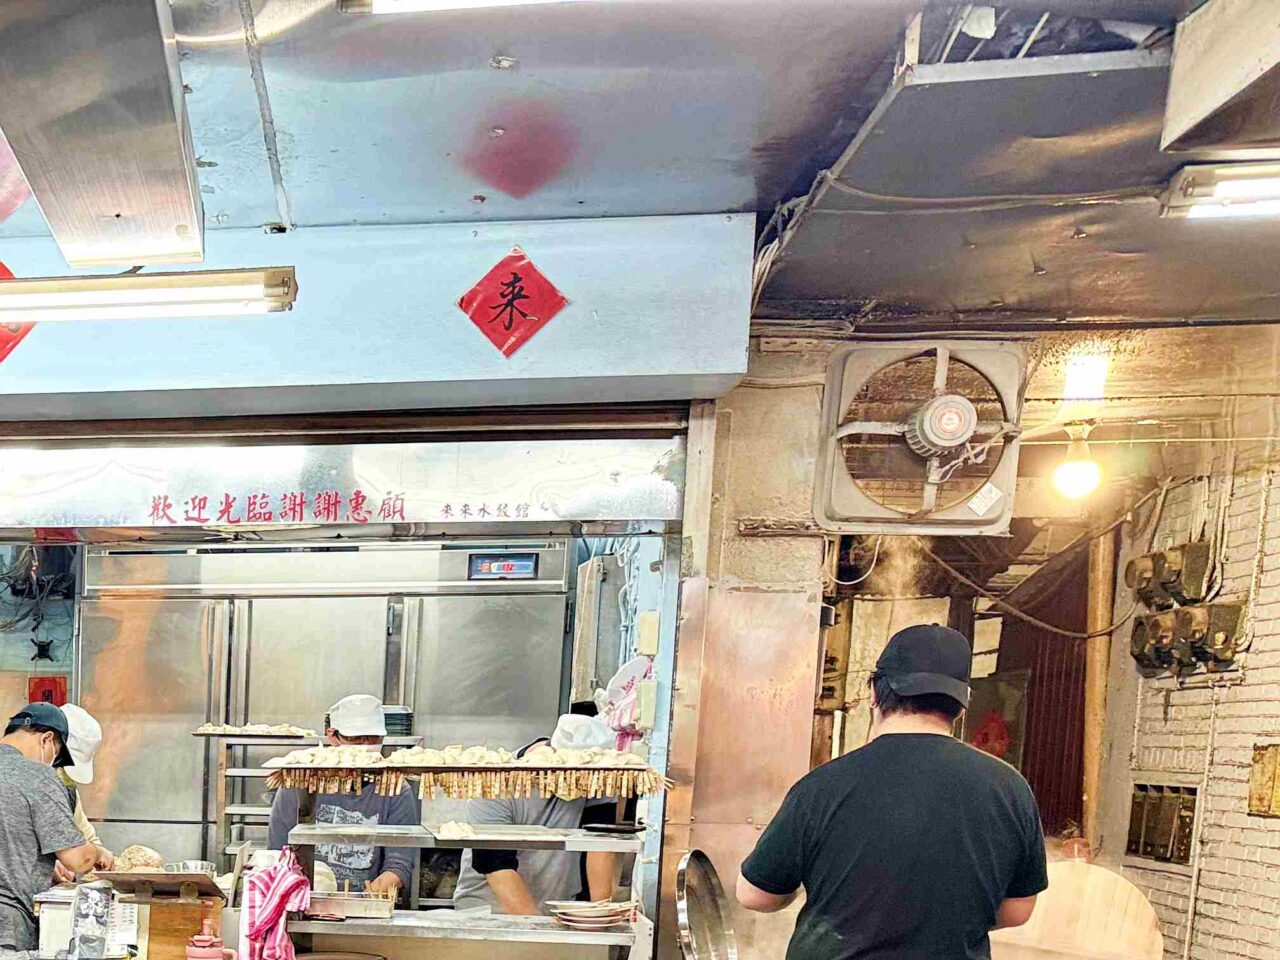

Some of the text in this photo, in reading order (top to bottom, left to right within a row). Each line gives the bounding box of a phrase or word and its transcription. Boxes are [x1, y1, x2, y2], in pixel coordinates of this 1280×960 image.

[149, 490, 407, 524] 歡迎光臨謝謝惠顧
